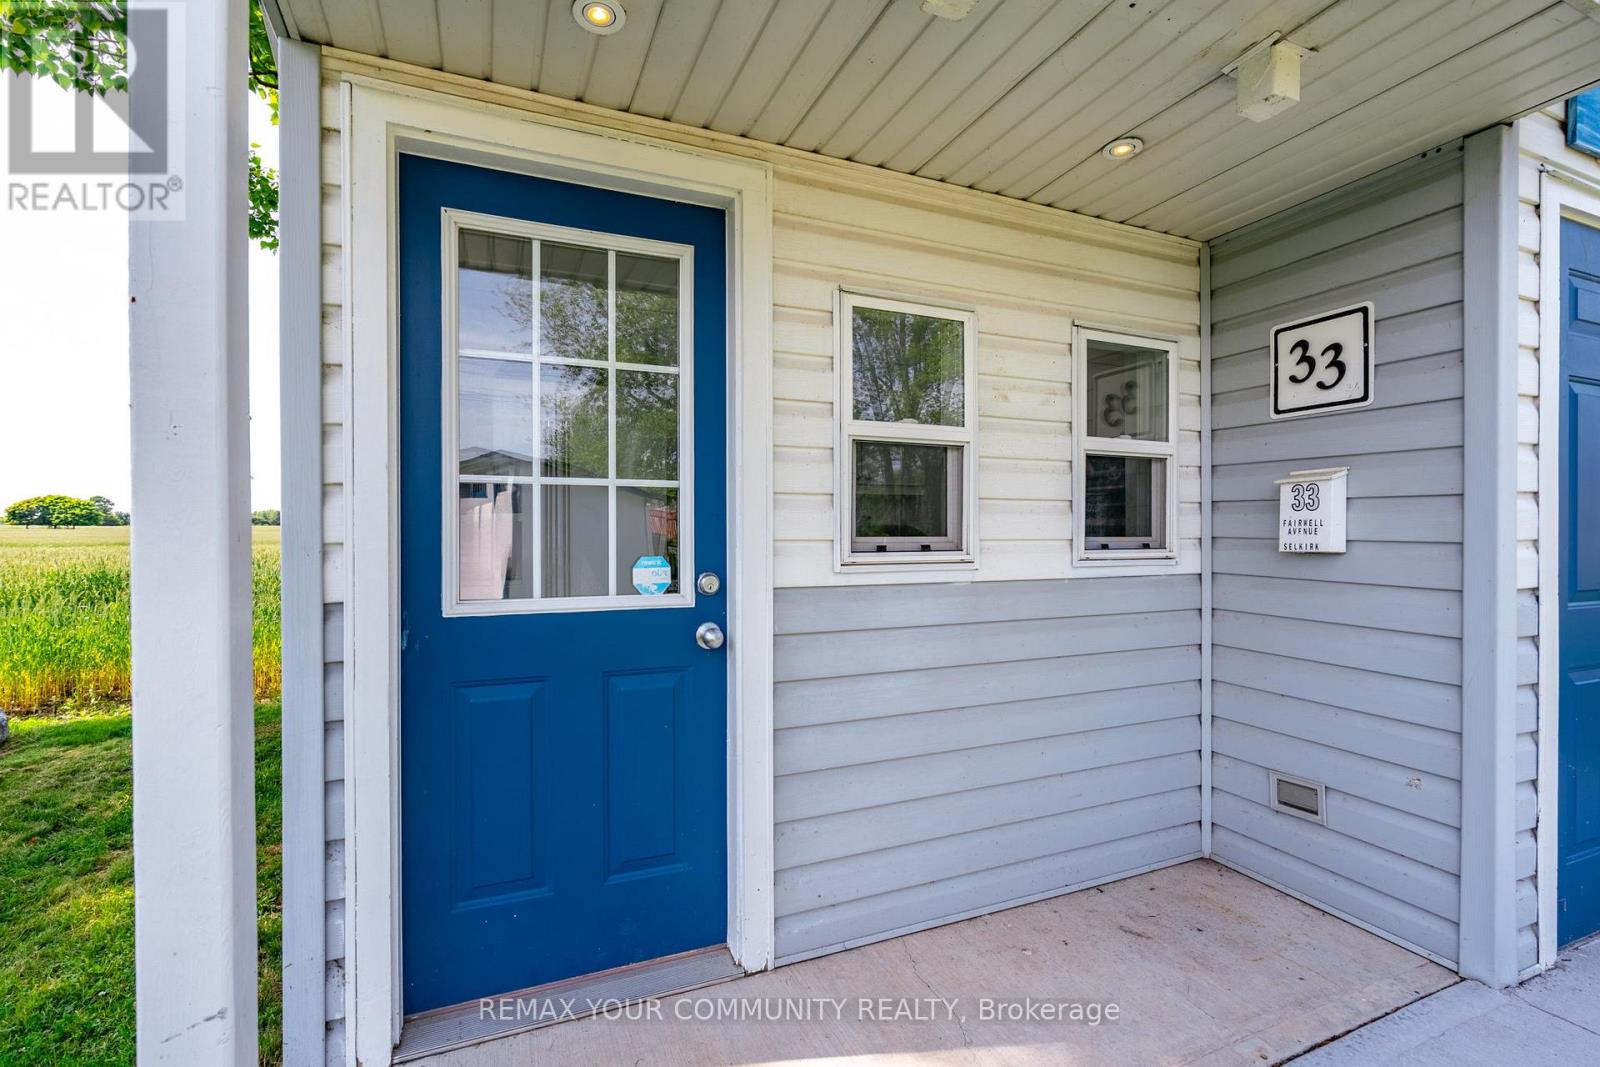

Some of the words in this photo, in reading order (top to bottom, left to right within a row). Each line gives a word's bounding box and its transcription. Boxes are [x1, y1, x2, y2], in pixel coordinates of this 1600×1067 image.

[1288, 339, 1347, 390] 33
[1291, 483, 1320, 512] 33
[1287, 527, 1319, 536] AVENUE
[1283, 542, 1320, 551] SELKIRK
